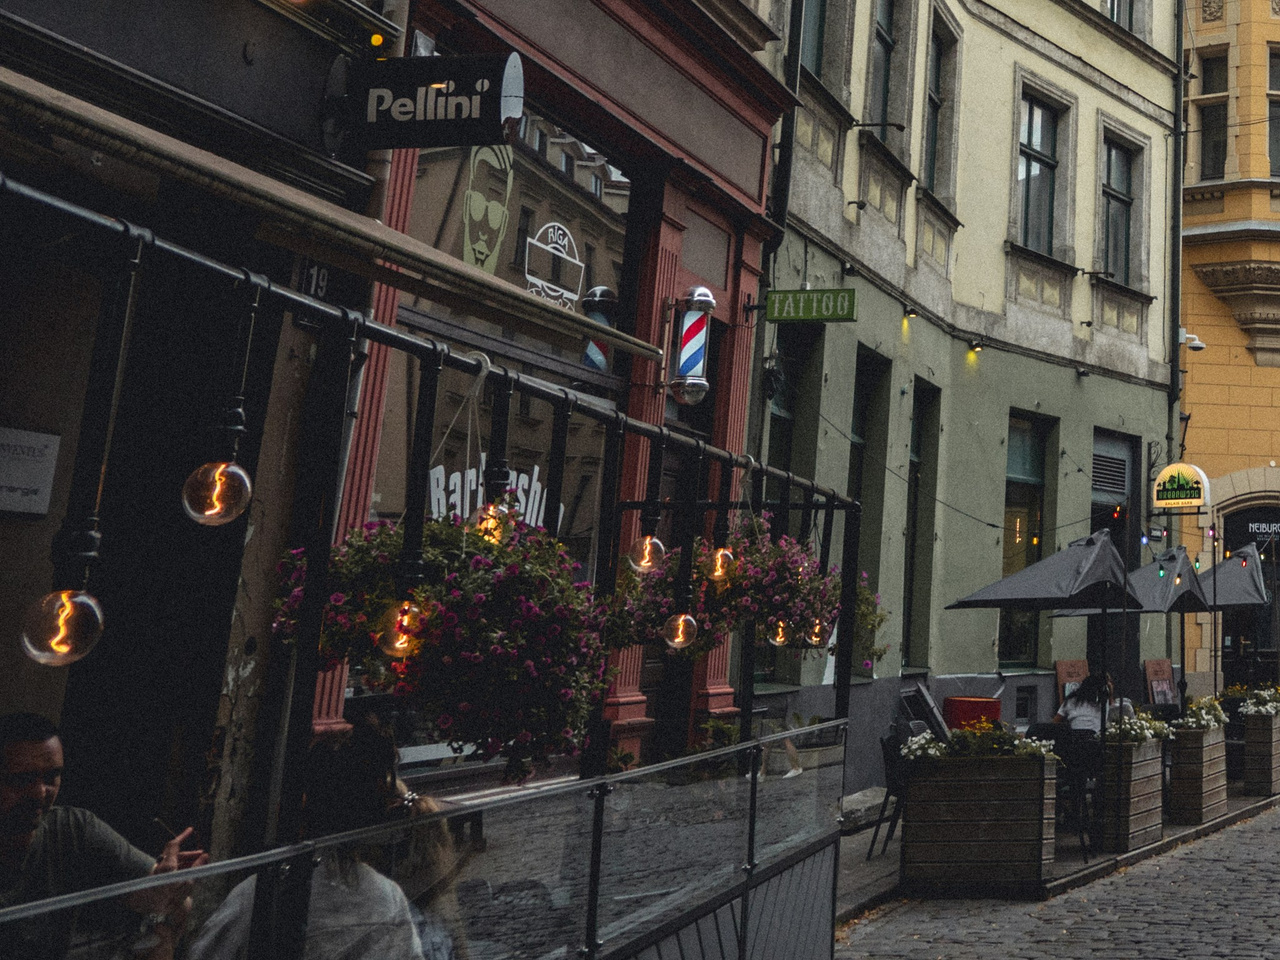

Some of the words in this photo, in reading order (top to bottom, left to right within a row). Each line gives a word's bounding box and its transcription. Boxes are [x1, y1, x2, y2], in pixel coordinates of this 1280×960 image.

[366, 78, 490, 123] Pellini
[309, 265, 329, 298] 19
[771, 293, 849, 318] TATTOO
